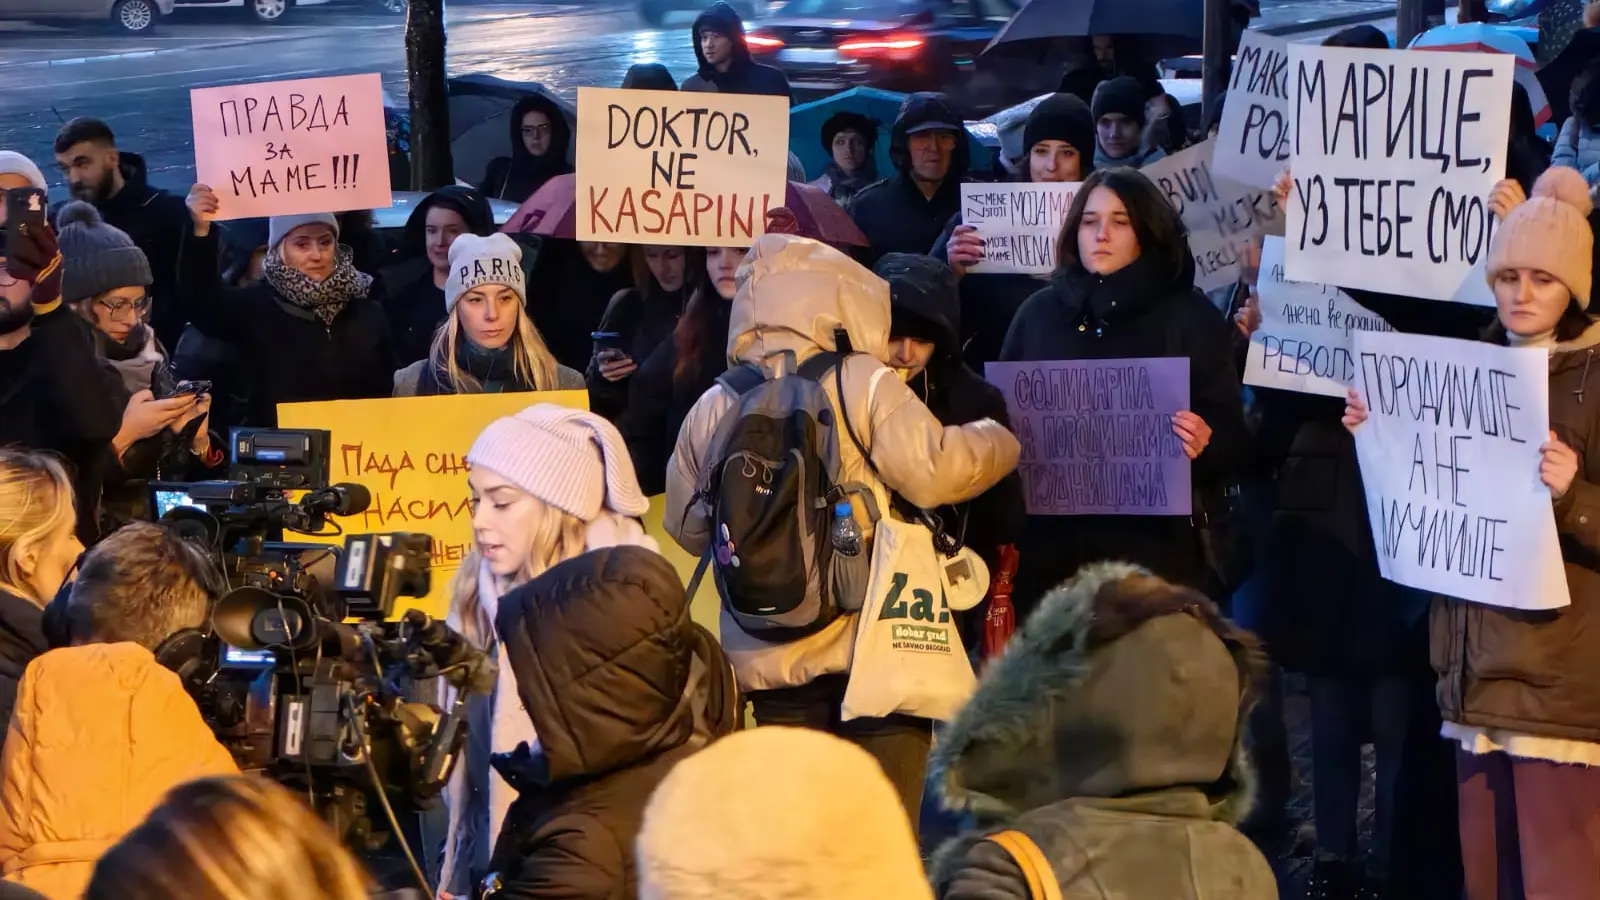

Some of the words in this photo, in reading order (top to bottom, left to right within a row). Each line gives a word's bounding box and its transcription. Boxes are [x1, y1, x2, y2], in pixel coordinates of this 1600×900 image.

[220, 94, 349, 137] ПРАВДА
[608, 104, 758, 157] DOKTOR,
[1296, 60, 1494, 173] МАРИЦЕ,
[264, 142, 294, 161] ЗА
[651, 150, 698, 190] NE
[230, 154, 360, 198] МАМЕ!!!
[967, 194, 984, 224] IZA
[985, 193, 1008, 206] MENE
[1010, 191, 1046, 227] MOJA
[1049, 191, 1075, 227] MA
[1295, 174, 1328, 251] УЗ
[1334, 177, 1416, 258] ТЕБЕ
[460, 258, 521, 285] PARIS
[987, 250, 1011, 262] MAME
[1282, 303, 1321, 326] жена
[1361, 353, 1526, 443] ПОРОДИЛИШТЕ
[1409, 432, 1427, 495] А
[1434, 432, 1472, 507] НЕ
